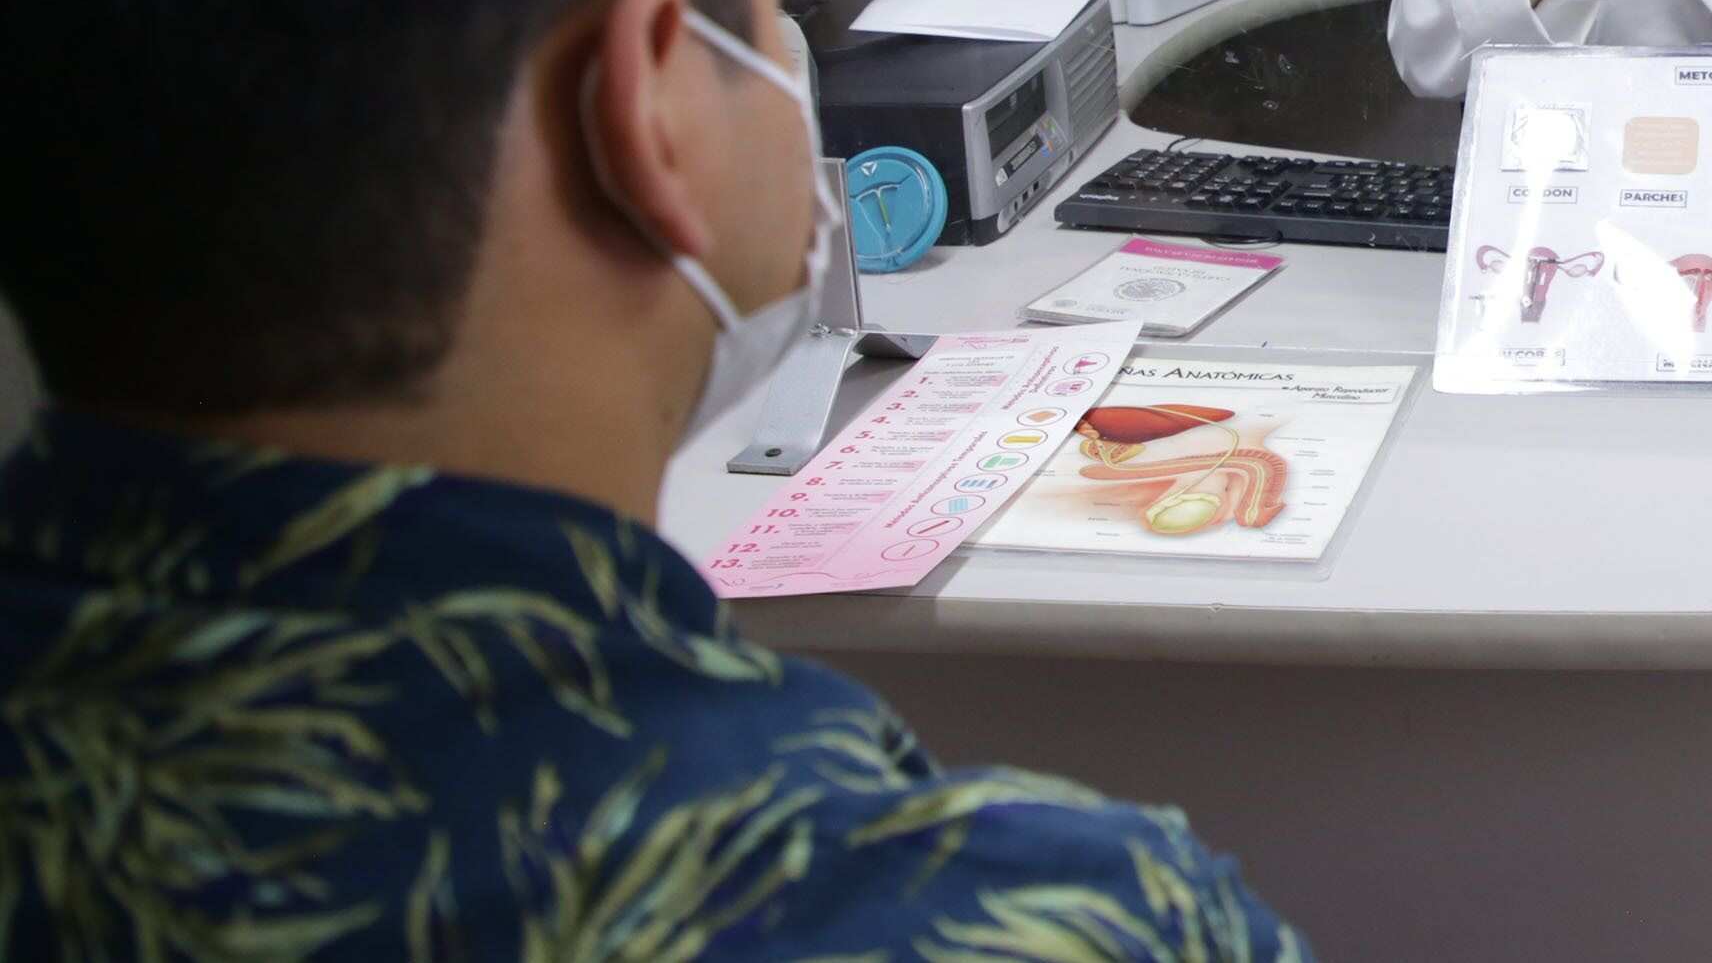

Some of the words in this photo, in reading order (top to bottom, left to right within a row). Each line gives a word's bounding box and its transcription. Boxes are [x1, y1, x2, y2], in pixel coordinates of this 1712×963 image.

[1512, 188, 1573, 198] CODON
[1624, 192, 1685, 203] PARCHES
[767, 508, 800, 518] 10.
[750, 525, 780, 534] 11.
[727, 543, 760, 553] 12.
[710, 558, 744, 569] 13.
